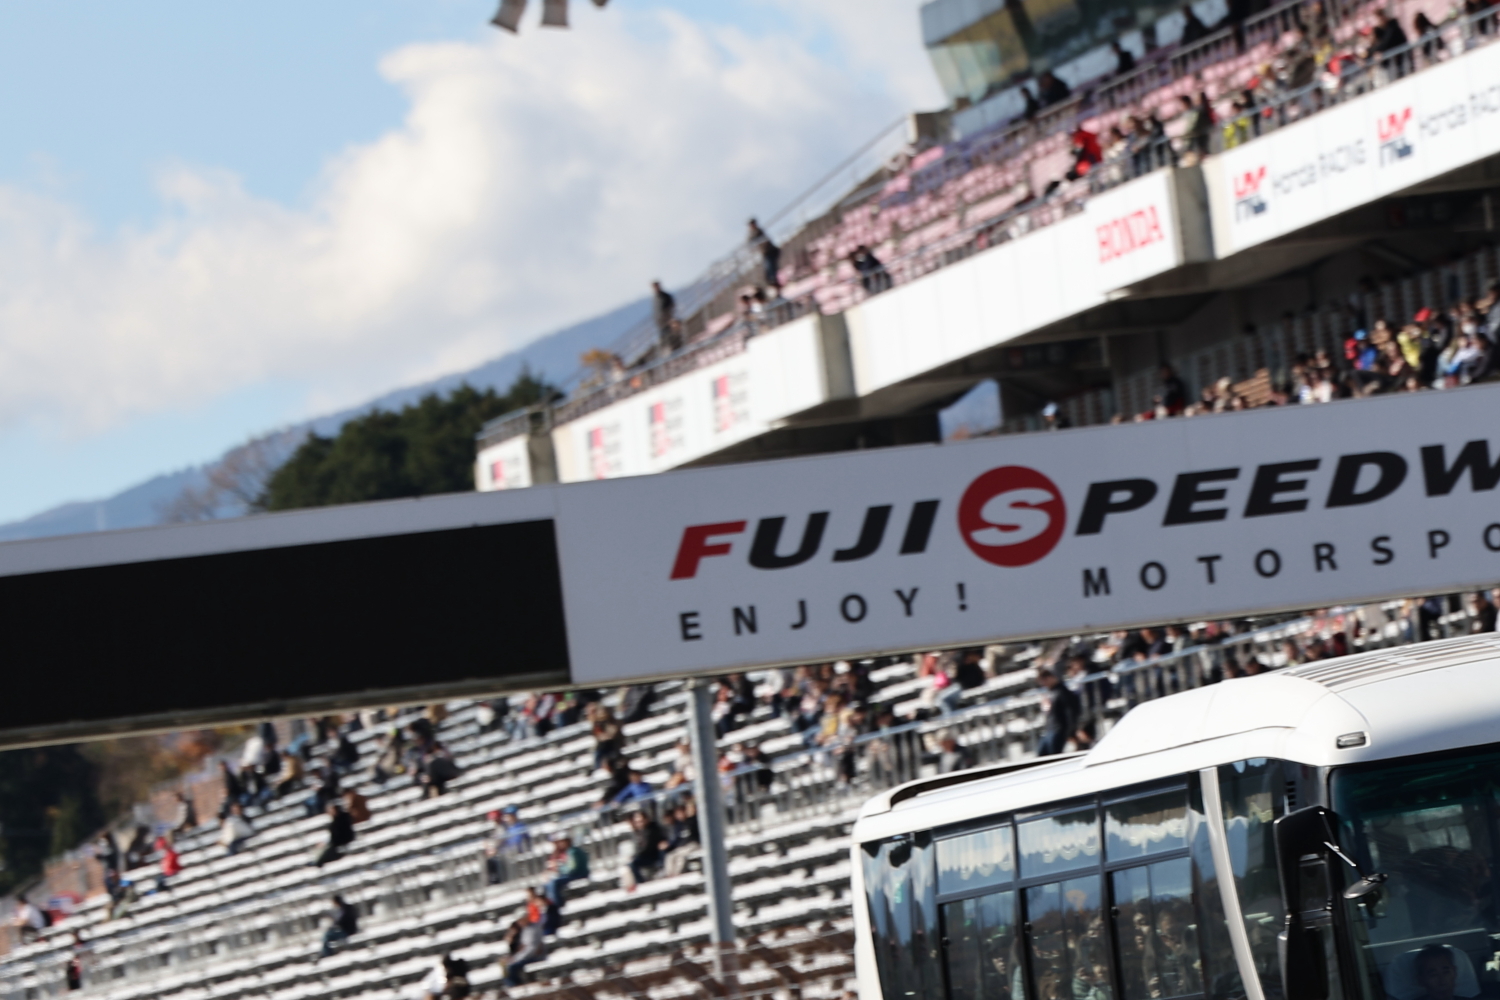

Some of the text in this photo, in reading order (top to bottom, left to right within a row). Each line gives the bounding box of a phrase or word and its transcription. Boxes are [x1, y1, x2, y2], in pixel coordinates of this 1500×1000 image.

[1096, 205, 1164, 264] HONDA
[669, 499, 941, 581] FUJI
[680, 582, 968, 641] ENJOY!
